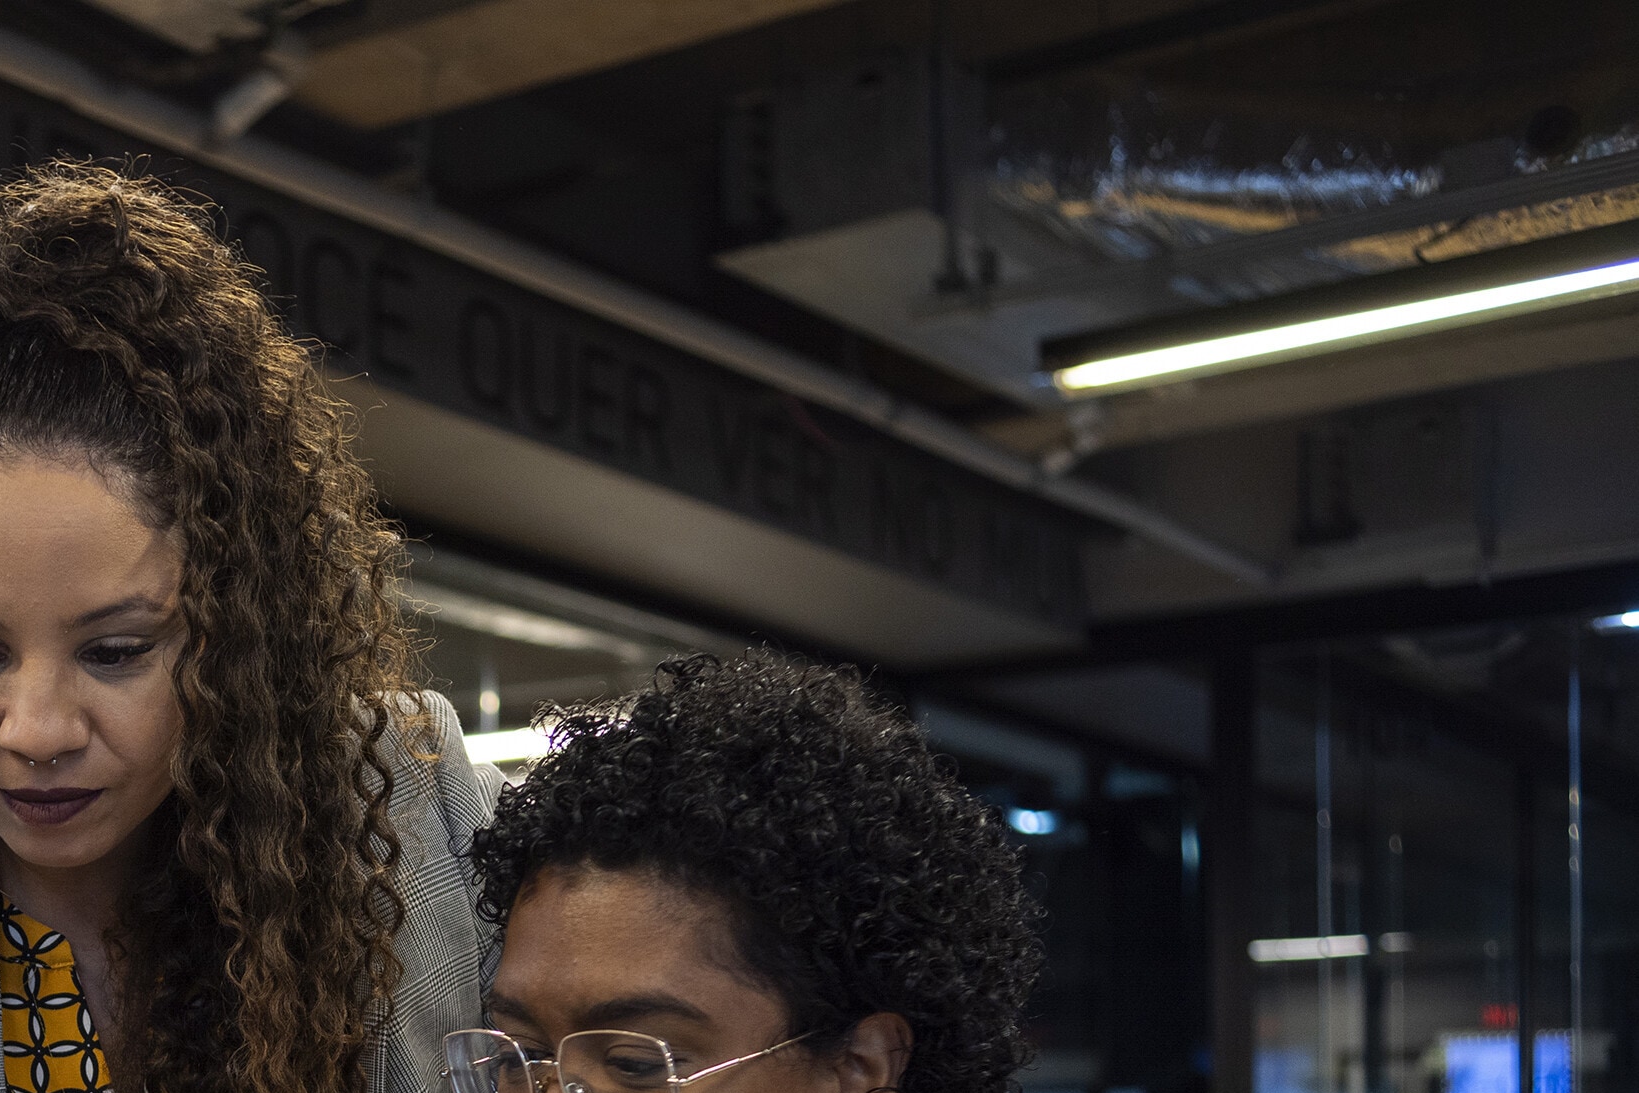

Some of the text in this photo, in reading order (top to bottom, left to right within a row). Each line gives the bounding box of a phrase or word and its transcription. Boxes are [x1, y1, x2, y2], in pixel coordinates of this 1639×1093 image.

[459, 298, 671, 472] QUER
[705, 390, 839, 540] VER
[870, 452, 958, 577] NO
